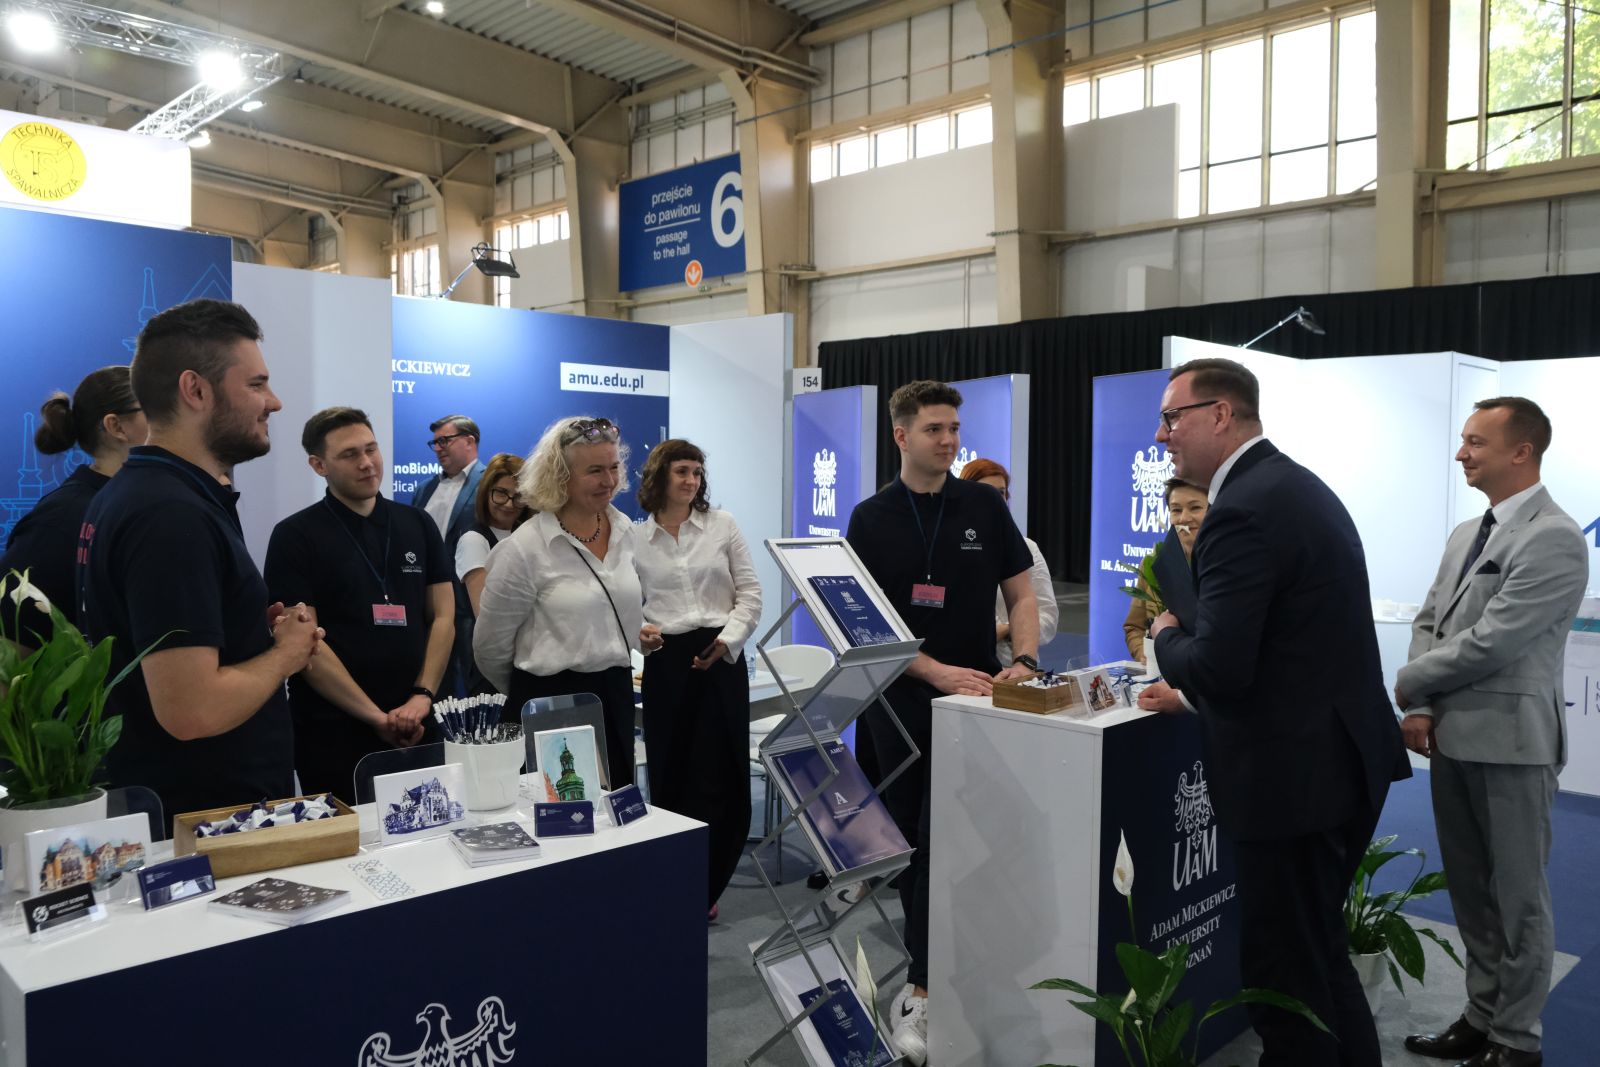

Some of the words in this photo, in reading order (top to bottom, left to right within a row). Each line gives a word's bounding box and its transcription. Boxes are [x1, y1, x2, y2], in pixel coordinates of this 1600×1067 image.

[11, 123, 73, 149] TECHNIKA
[6, 168, 79, 199] SPAWALNICZA
[651, 184, 693, 207] przejście
[644, 211, 656, 225] do
[658, 203, 700, 225] pawilonu
[711, 171, 745, 248] 6
[656, 230, 688, 247] passage
[653, 251, 661, 260] to
[663, 247, 675, 259] the
[676, 243, 690, 256] hall
[568, 371, 644, 392] amu.edu.pl
[802, 376, 819, 388] 154
[1150, 912, 1180, 942] ADAM
[1181, 884, 1237, 925] MICKIEWICZ
[1186, 939, 1212, 969] ZNAŃ
